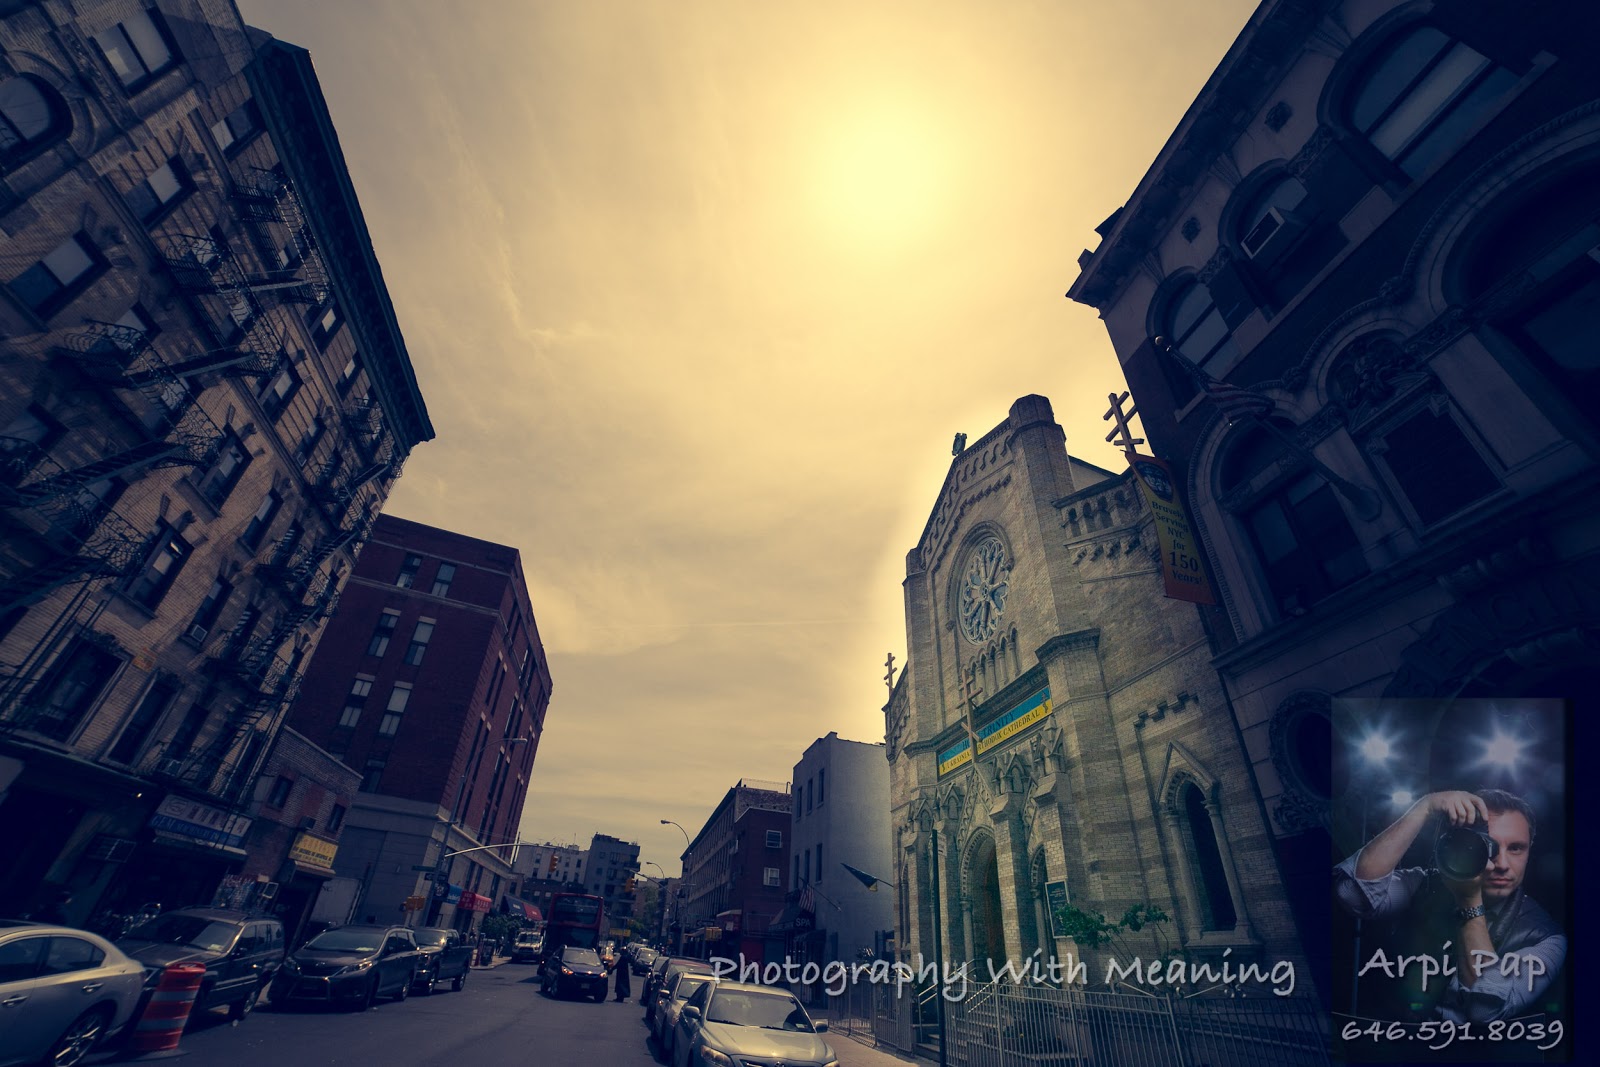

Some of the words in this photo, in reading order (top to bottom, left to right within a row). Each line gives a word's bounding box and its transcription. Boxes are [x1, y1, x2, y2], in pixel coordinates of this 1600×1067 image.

[1152, 501, 1185, 519] Bravely
[1155, 512, 1189, 533] Serving
[1167, 526, 1185, 540] NYC
[1173, 539, 1187, 551] for
[1169, 551, 1199, 572] 150
[1172, 569, 1202, 585] Years!
[983, 711, 1015, 738] TRINITY
[946, 749, 972, 770] UKRAINIA
[977, 726, 1003, 751] RTHODOX
[1003, 709, 1041, 736] CATHEDRAL
[795, 917, 811, 928] SPA
